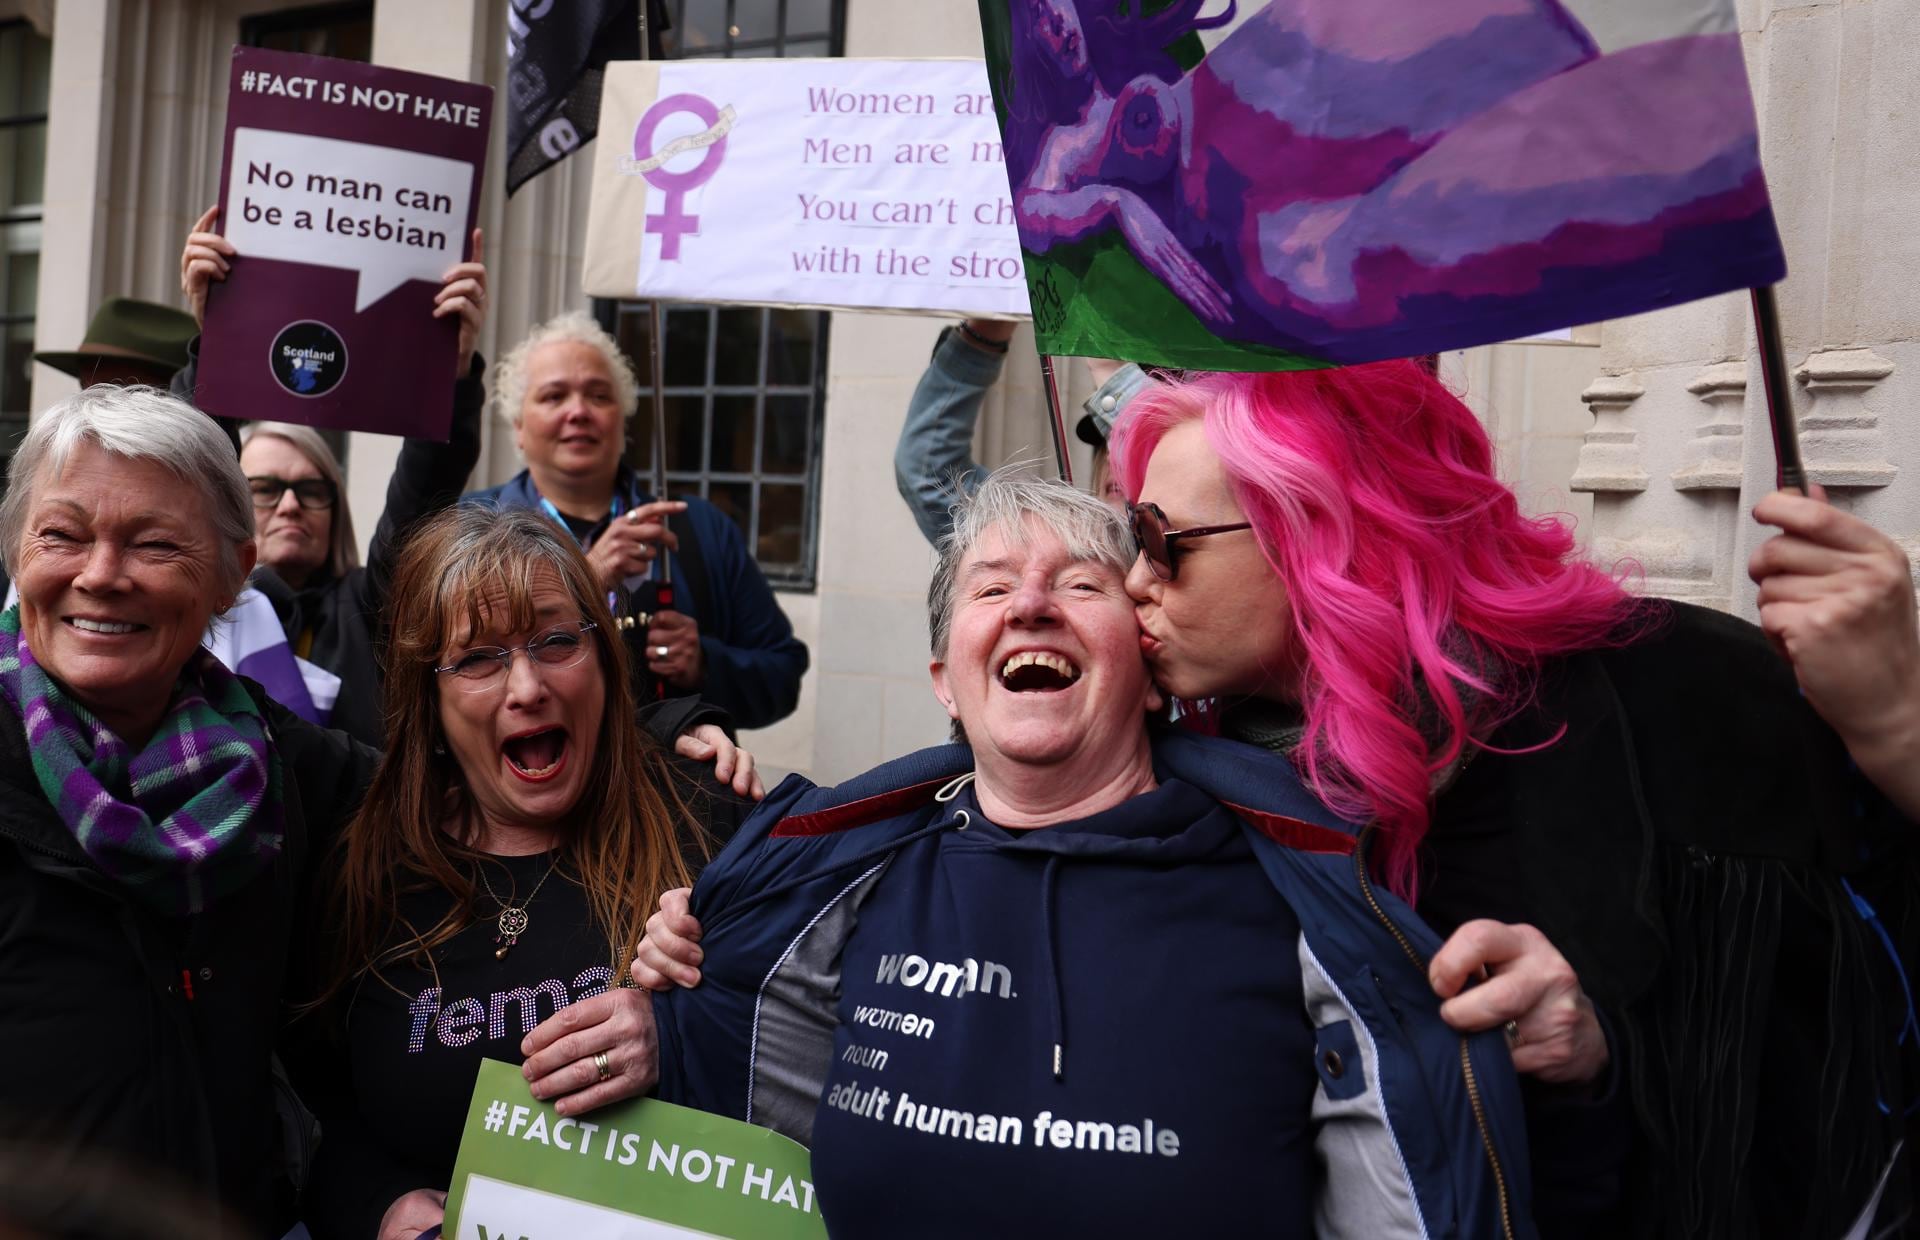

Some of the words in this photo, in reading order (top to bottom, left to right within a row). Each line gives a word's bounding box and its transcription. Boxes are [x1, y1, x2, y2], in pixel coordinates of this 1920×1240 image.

[241, 70, 317, 99] #FACT
[322, 81, 346, 104] IS
[351, 86, 409, 113] NOT
[413, 96, 481, 127] HATE
[806, 86, 935, 114] Women
[953, 93, 996, 115] ar
[802, 138, 873, 163] Men
[894, 142, 949, 164] are
[247, 160, 294, 189] No
[306, 173, 382, 202] man
[395, 187, 452, 214] can
[243, 197, 282, 225] be
[294, 209, 313, 230] a
[325, 207, 446, 250] lesbian
[797, 193, 857, 223] You
[872, 197, 958, 225] can't
[792, 246, 861, 274] with
[875, 248, 931, 276] the
[949, 251, 1026, 279] stro
[283, 345, 335, 362] Scotland
[842, 1044, 889, 1072] noun
[827, 1080, 891, 1122] adult
[893, 1091, 1024, 1146] human
[1033, 1110, 1181, 1157] female
[483, 1100, 599, 1155] #FACT
[604, 1128, 640, 1166] IS
[647, 1139, 736, 1190] NOT
[742, 1162, 823, 1219] HAT
